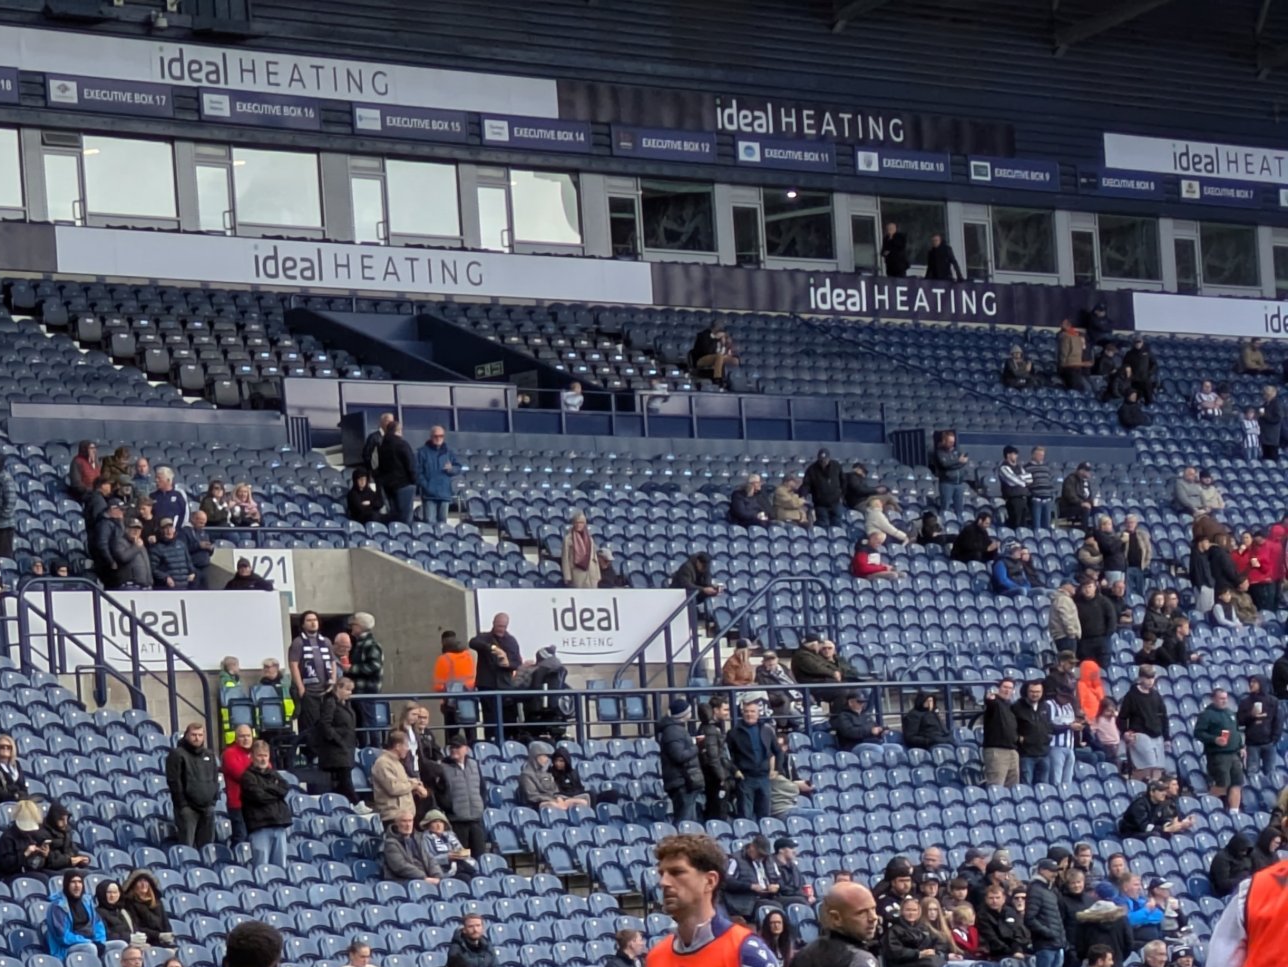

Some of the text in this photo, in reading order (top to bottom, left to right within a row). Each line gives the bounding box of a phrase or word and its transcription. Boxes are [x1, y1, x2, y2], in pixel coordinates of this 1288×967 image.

[158, 46, 389, 96] ideal HEATING
[0, 79, 12, 91] 18
[83, 88, 132, 103] EXECUTIVE
[134, 93, 154, 105] BOX
[155, 95, 166, 106] 17
[236, 101, 281, 115] EXECUTIVE
[283, 106, 302, 117] BOX
[386, 116, 430, 129] EXECUTIVE
[432, 120, 449, 131] BOX
[716, 97, 904, 142] ideal HEATING
[513, 127, 556, 140] EXECUTIVE
[557, 131, 573, 141] BOX
[642, 137, 682, 151] EXECUTIVE
[683, 141, 700, 152] BOX
[701, 142, 710, 153] 12
[765, 148, 803, 160] EXECUTIVE
[804, 151, 820, 162] BOX
[1172, 143, 1220, 174] ideal
[883, 158, 919, 170] EXECUTIVE
[920, 161, 934, 172] BOX
[254, 244, 483, 287] ideal HEATING
[809, 277, 997, 316] ideal HEATING
[109, 599, 189, 637] ideal
[551, 596, 620, 632] ideal
[120, 642, 181, 655] HATI
[562, 636, 615, 648] HEATING
